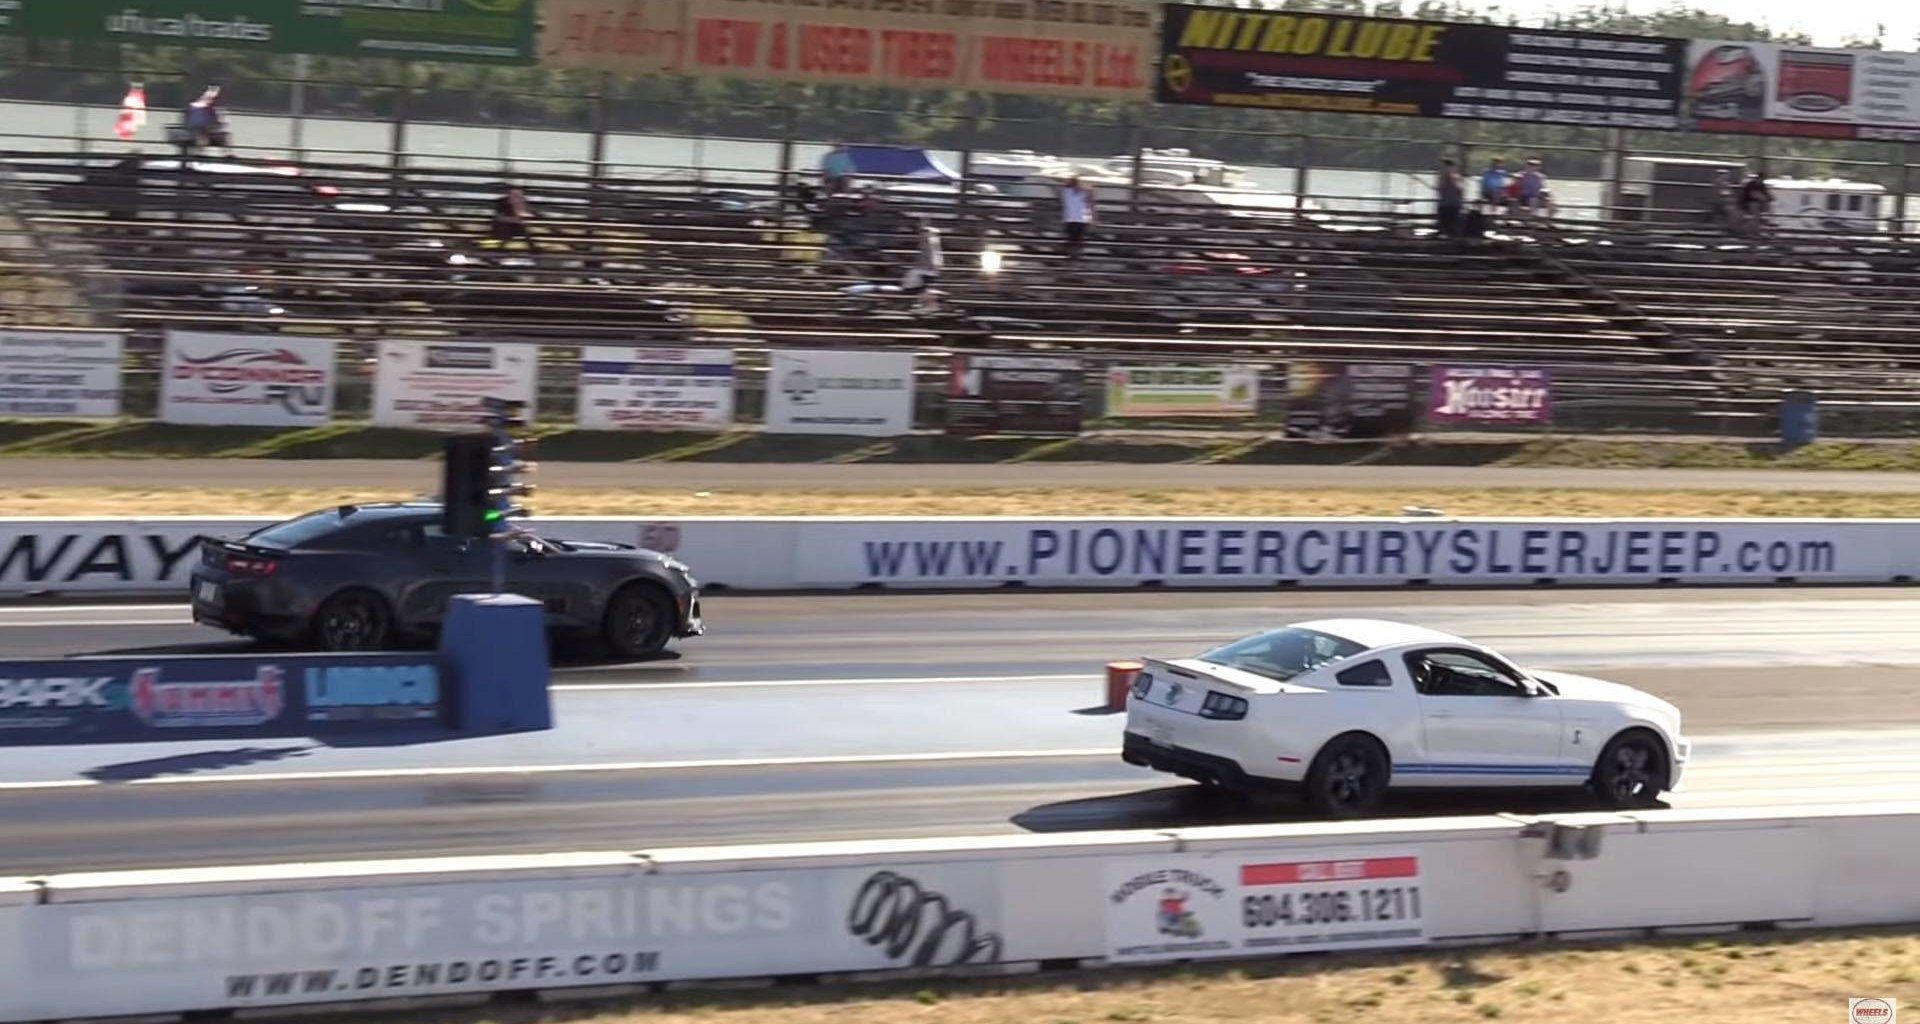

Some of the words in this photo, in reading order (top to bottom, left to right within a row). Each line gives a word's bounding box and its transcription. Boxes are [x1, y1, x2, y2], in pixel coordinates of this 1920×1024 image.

[696, 18, 762, 67] NEW
[799, 23, 871, 74] USED
[882, 29, 956, 79] TIRES
[980, 34, 1086, 86] WHEELS
[1180, 9, 1330, 55] NITRO
[1324, 21, 1446, 62] LUBE
[0, 534, 203, 581] WAY
[866, 528, 1837, 578] www.PIONEERCHRYSLERJEEP.com
[69, 896, 444, 968] DENDOFF
[474, 882, 794, 946] SPRINGS
[1241, 886, 1422, 928] 604.306.1211
[224, 950, 662, 998] WWW.DENDOFF.COM
